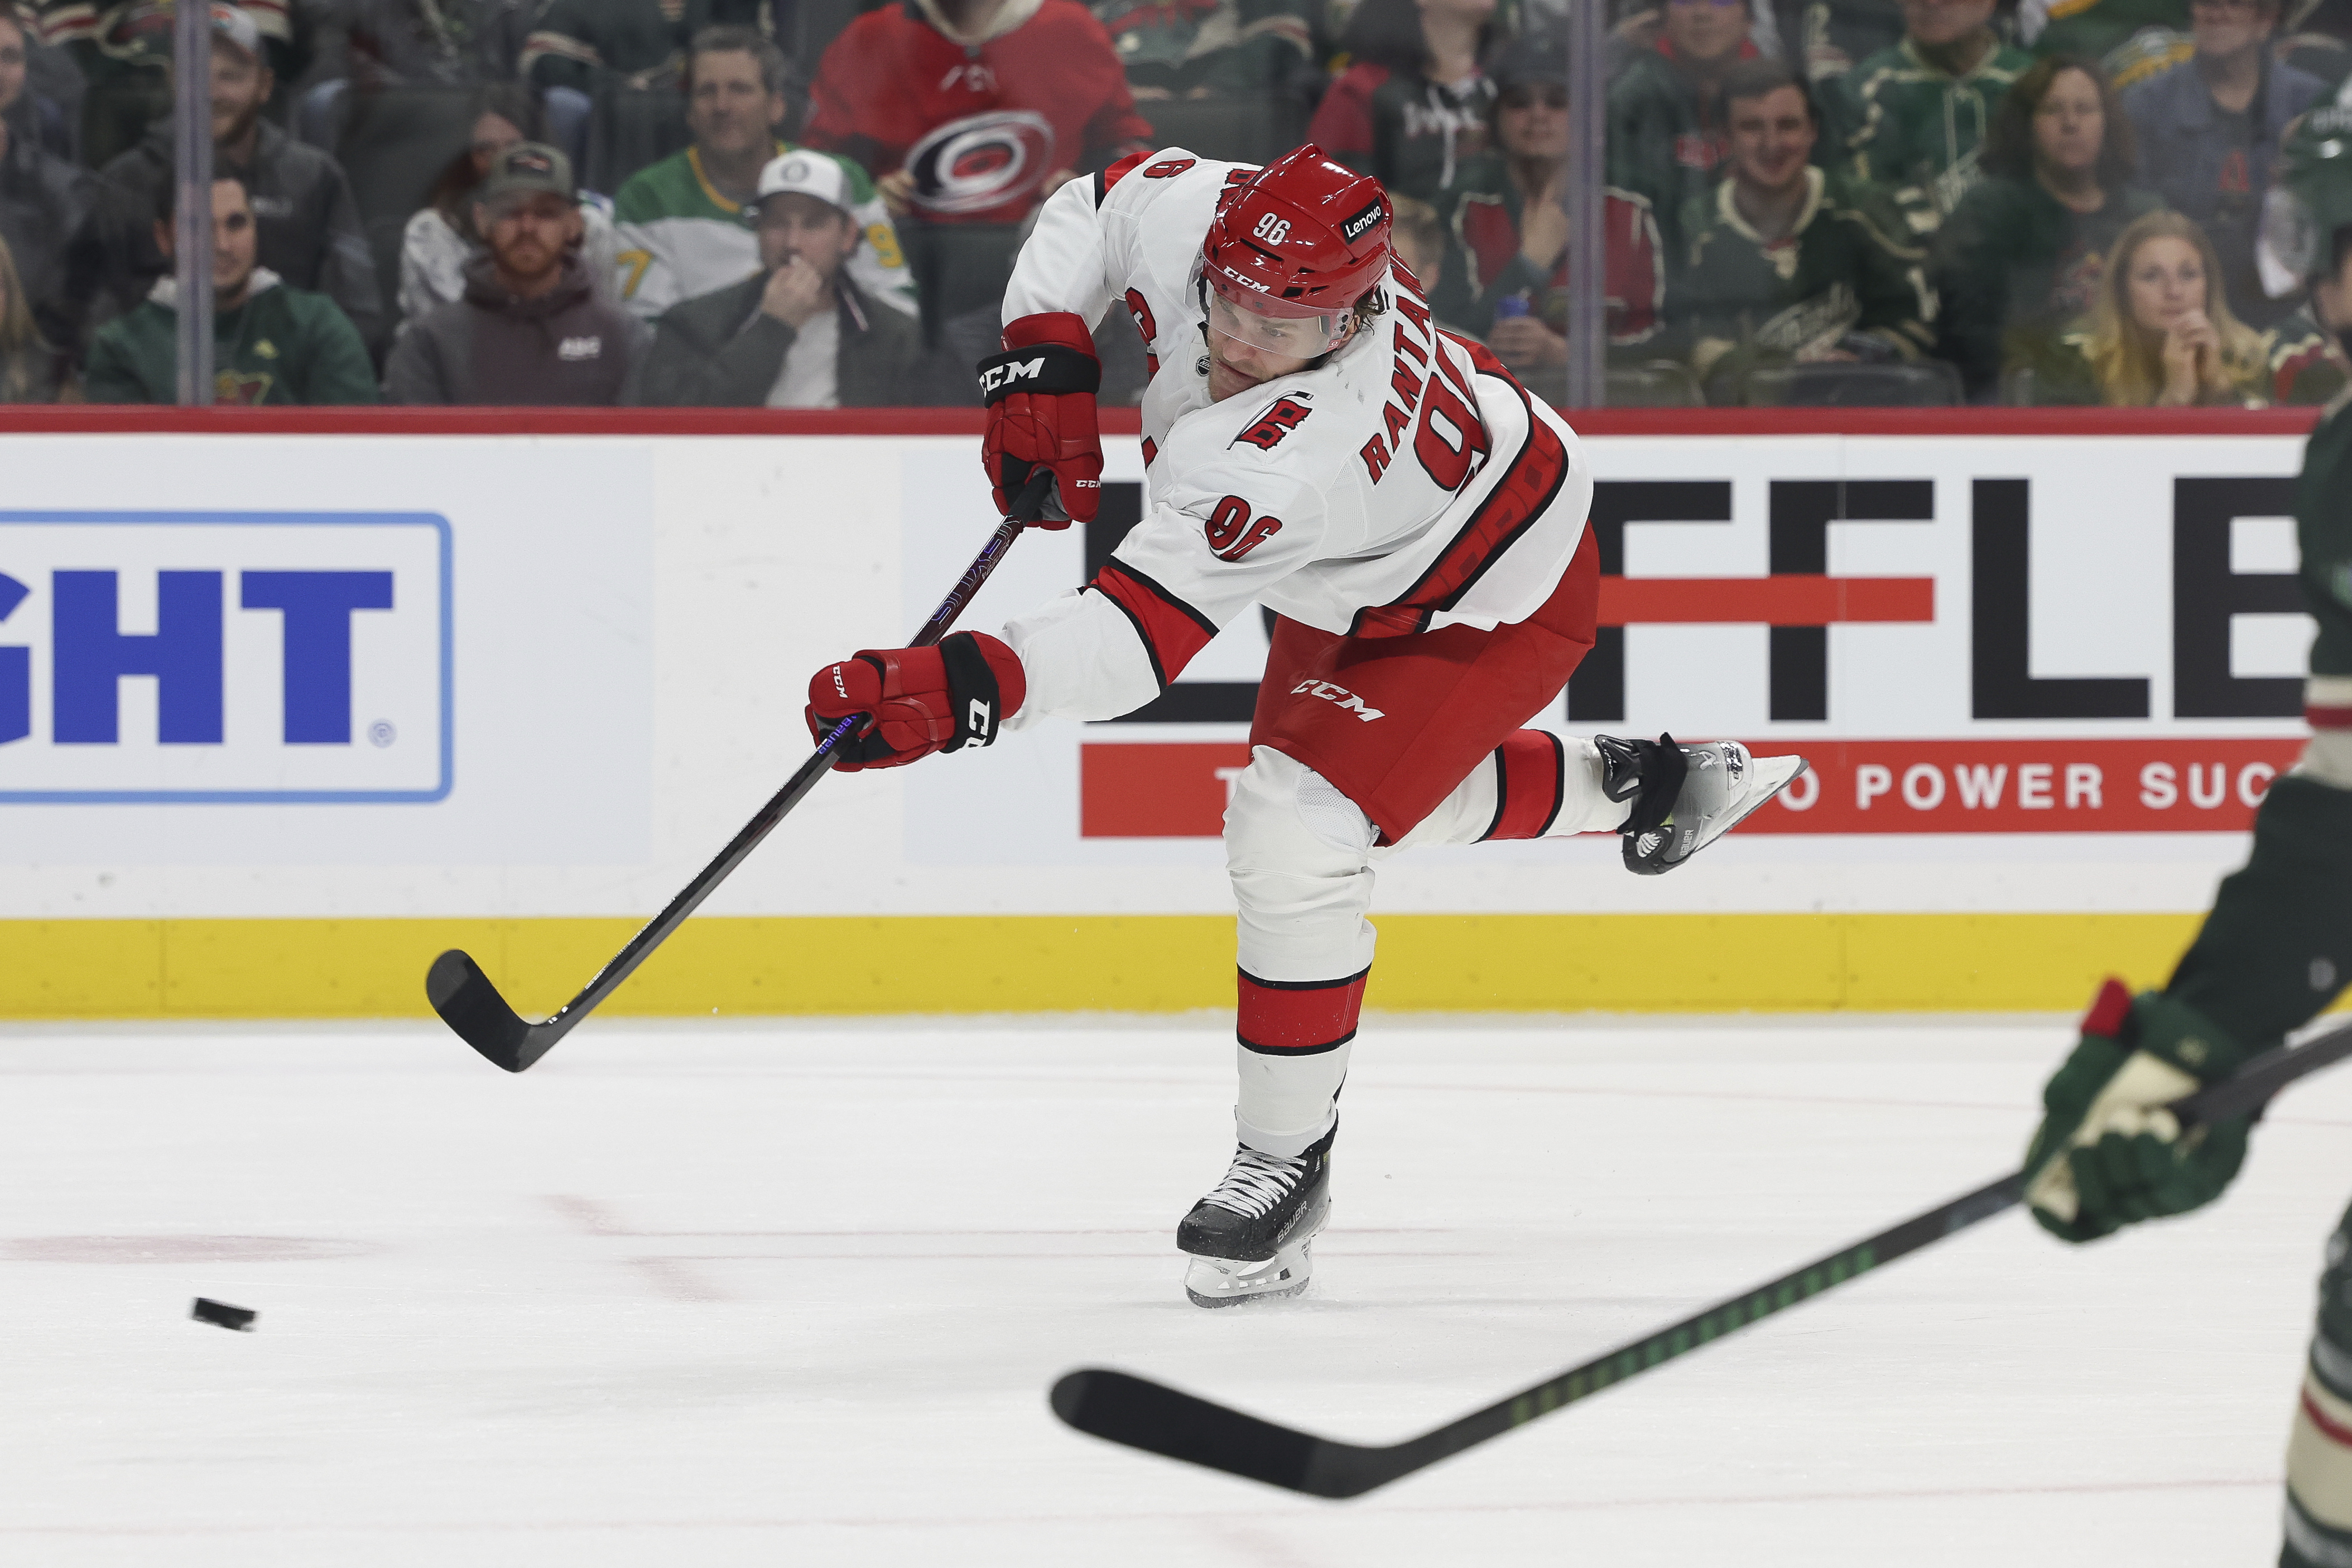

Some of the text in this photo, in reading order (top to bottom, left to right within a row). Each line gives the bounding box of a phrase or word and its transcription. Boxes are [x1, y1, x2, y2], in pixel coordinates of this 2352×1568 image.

[1252, 212, 1292, 246] 96
[1345, 205, 1381, 238] Lenovo
[1224, 265, 1271, 293] CCM
[1205, 495, 1283, 562] 96
[833, 665, 848, 698] CCM
[1290, 679, 1386, 723] CCM
[1856, 762, 2103, 810] POWER
[2139, 762, 2277, 810] SUC
[1277, 1200, 1307, 1244] BAUER
